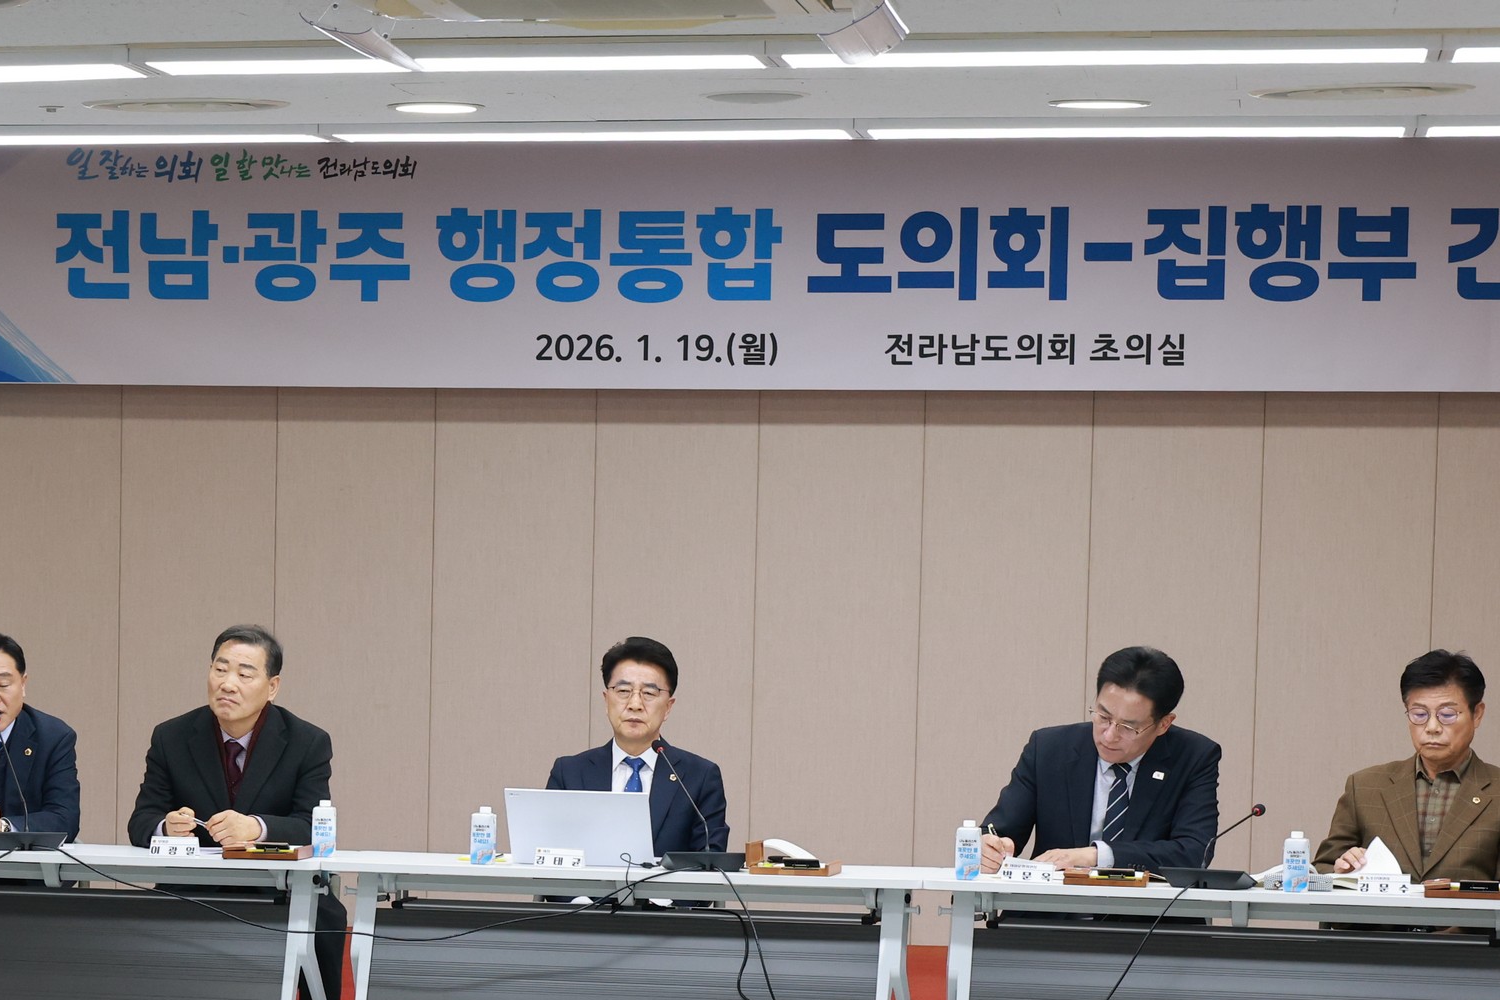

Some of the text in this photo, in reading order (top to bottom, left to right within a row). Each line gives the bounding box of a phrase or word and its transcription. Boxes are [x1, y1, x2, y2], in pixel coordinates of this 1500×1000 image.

[154, 151, 204, 183] 의회
[317, 156, 418, 180] 전라남도의회
[436, 206, 783, 304] 행정통합
[535, 333, 778, 367] 2026. 1. 19.(월)
[884, 333, 1185, 367] 전라남도의회 초의실
